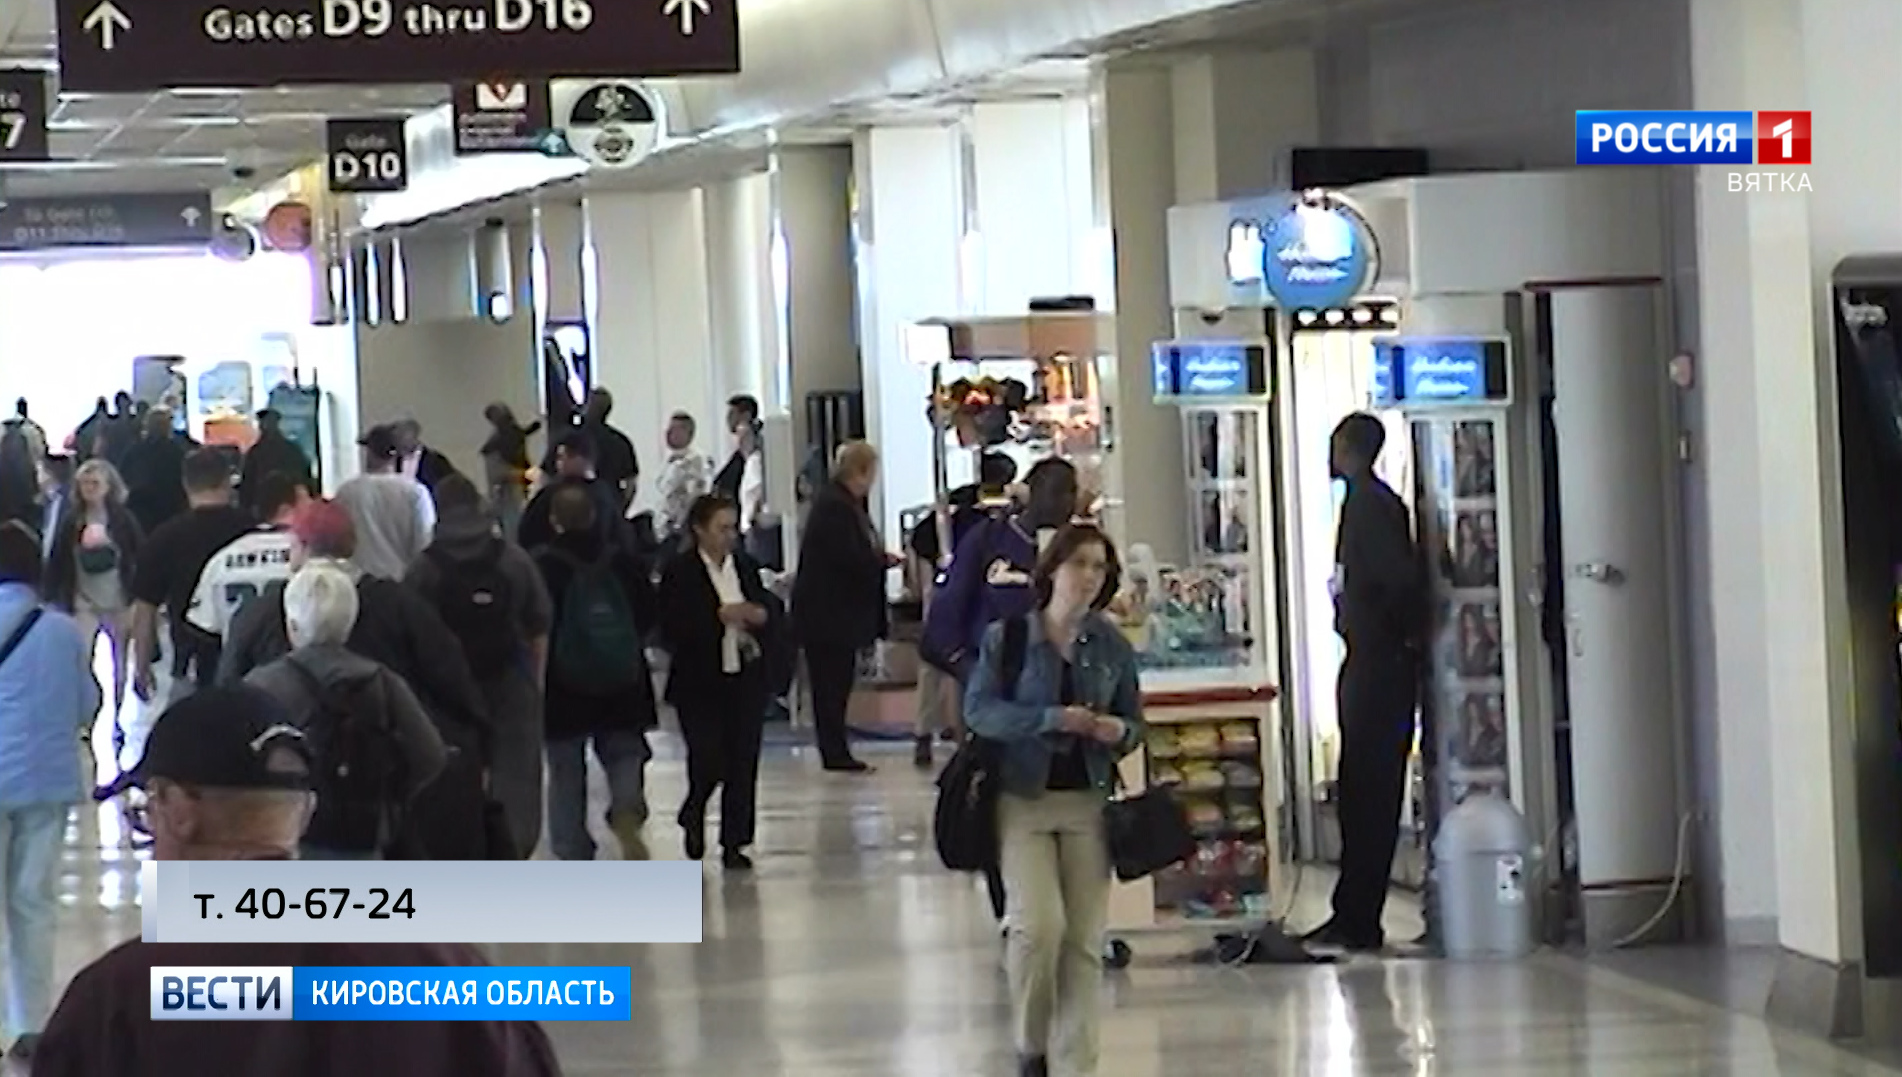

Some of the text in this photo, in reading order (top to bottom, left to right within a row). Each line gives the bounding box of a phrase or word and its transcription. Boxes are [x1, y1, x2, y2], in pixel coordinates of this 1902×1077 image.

[204, 0, 594, 41] Gates D9 thru D16
[334, 152, 401, 182] D10
